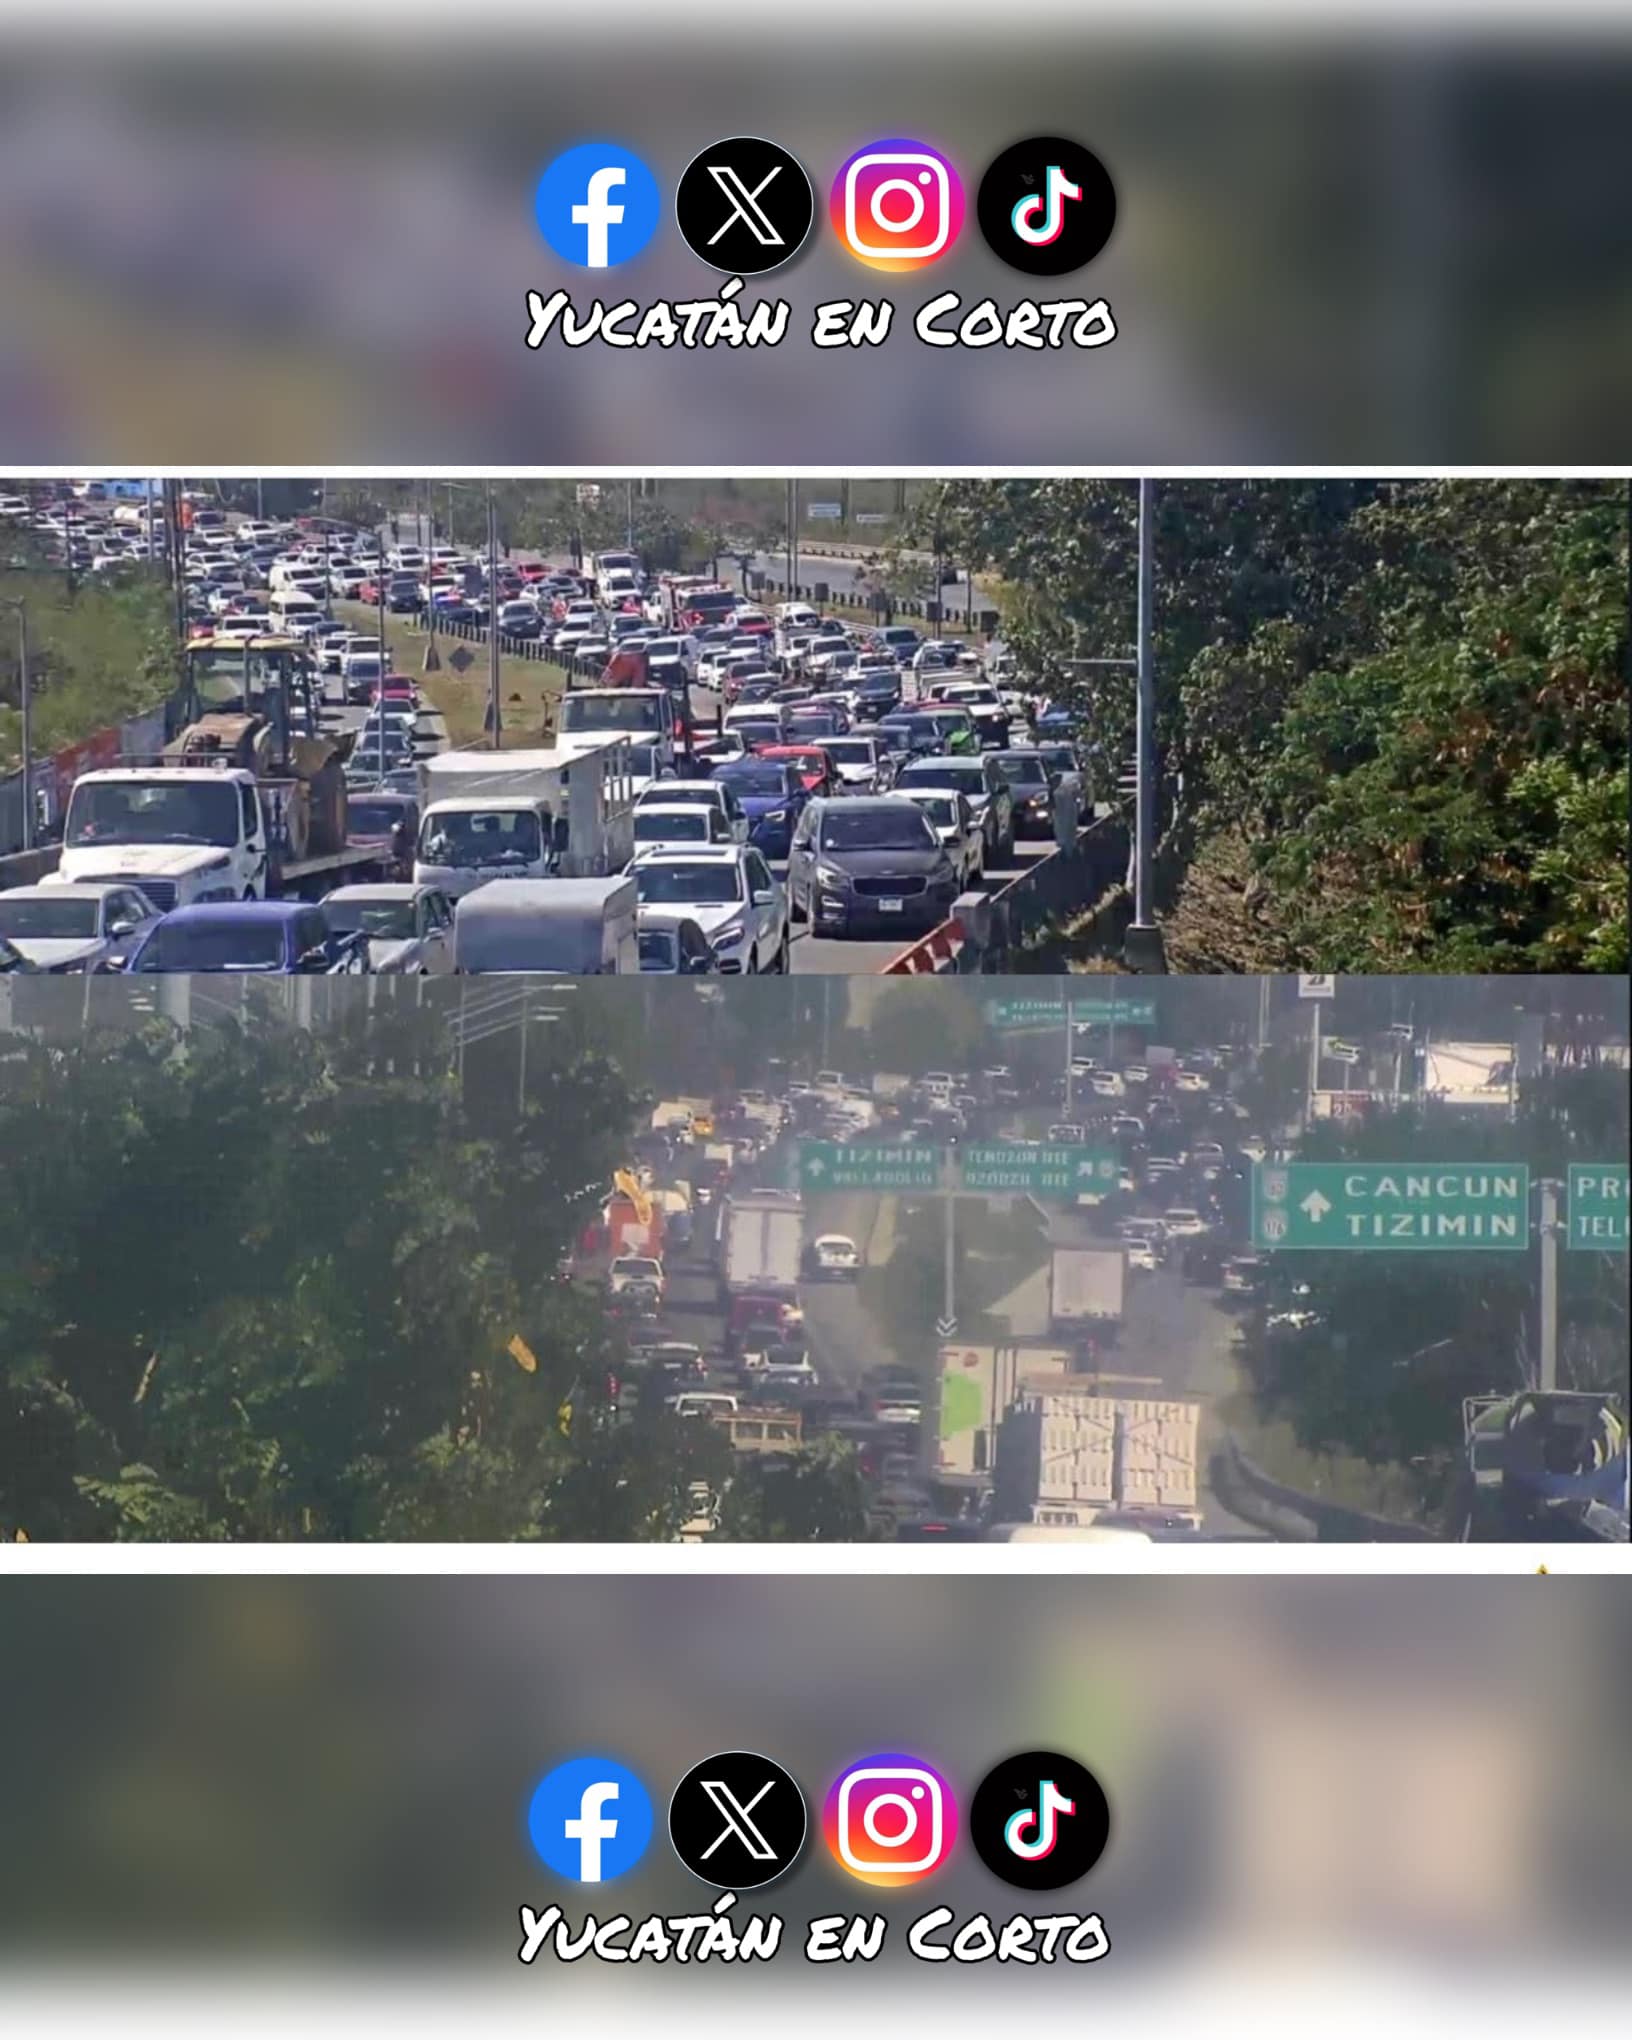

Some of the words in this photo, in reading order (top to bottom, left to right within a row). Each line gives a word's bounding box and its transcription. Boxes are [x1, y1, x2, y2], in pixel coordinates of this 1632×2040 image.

[1344, 1175, 1518, 1198] CANCUN
[1577, 1176, 1630, 1198] PR
[1345, 1213, 1517, 1237] TIZIMIN
[1578, 1215, 1630, 1238] TEL
